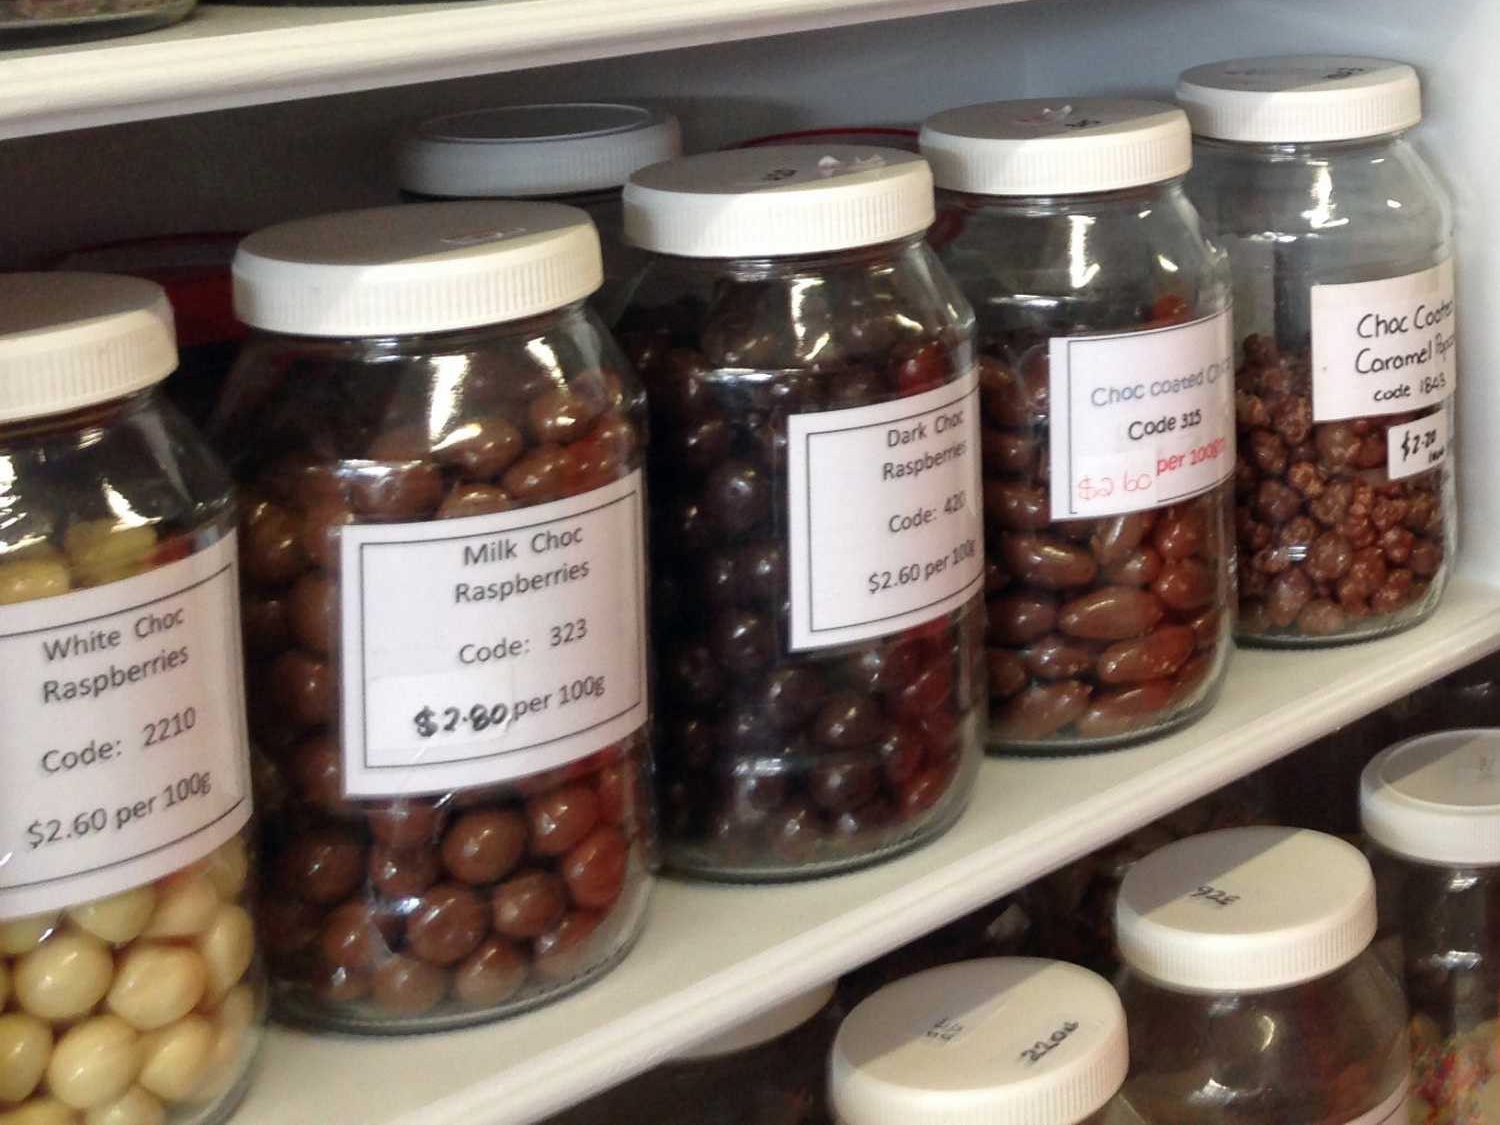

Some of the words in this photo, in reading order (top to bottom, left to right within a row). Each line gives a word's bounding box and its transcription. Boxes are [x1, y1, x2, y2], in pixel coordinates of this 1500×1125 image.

[1356, 313, 1410, 339] Choc
[1354, 339, 1433, 375] Caramel
[1090, 383, 1146, 408] Choc
[1150, 371, 1204, 398] coated
[1373, 383, 1411, 403] code
[886, 421, 928, 449] Dark
[933, 409, 965, 435] Choc
[1127, 415, 1177, 442] Code
[1180, 408, 1202, 431] 315
[1155, 453, 1186, 477] per
[888, 507, 938, 534] Code:
[462, 539, 518, 568] Milk
[530, 524, 585, 553] Choc
[454, 557, 591, 607] Raspberries
[867, 563, 921, 596] $2.60
[923, 554, 950, 582] per
[42, 627, 121, 663] White
[133, 605, 185, 641] Choc
[457, 636, 532, 667] Code:
[549, 617, 589, 649] 323
[42, 643, 190, 706] Raspberries
[510, 692, 552, 725] per
[557, 674, 607, 709] 100g
[41, 735, 122, 775] Code:
[142, 706, 197, 750] 2210
[26, 807, 107, 851] $2.60
[113, 792, 157, 832] per
[163, 770, 212, 812] 100g
